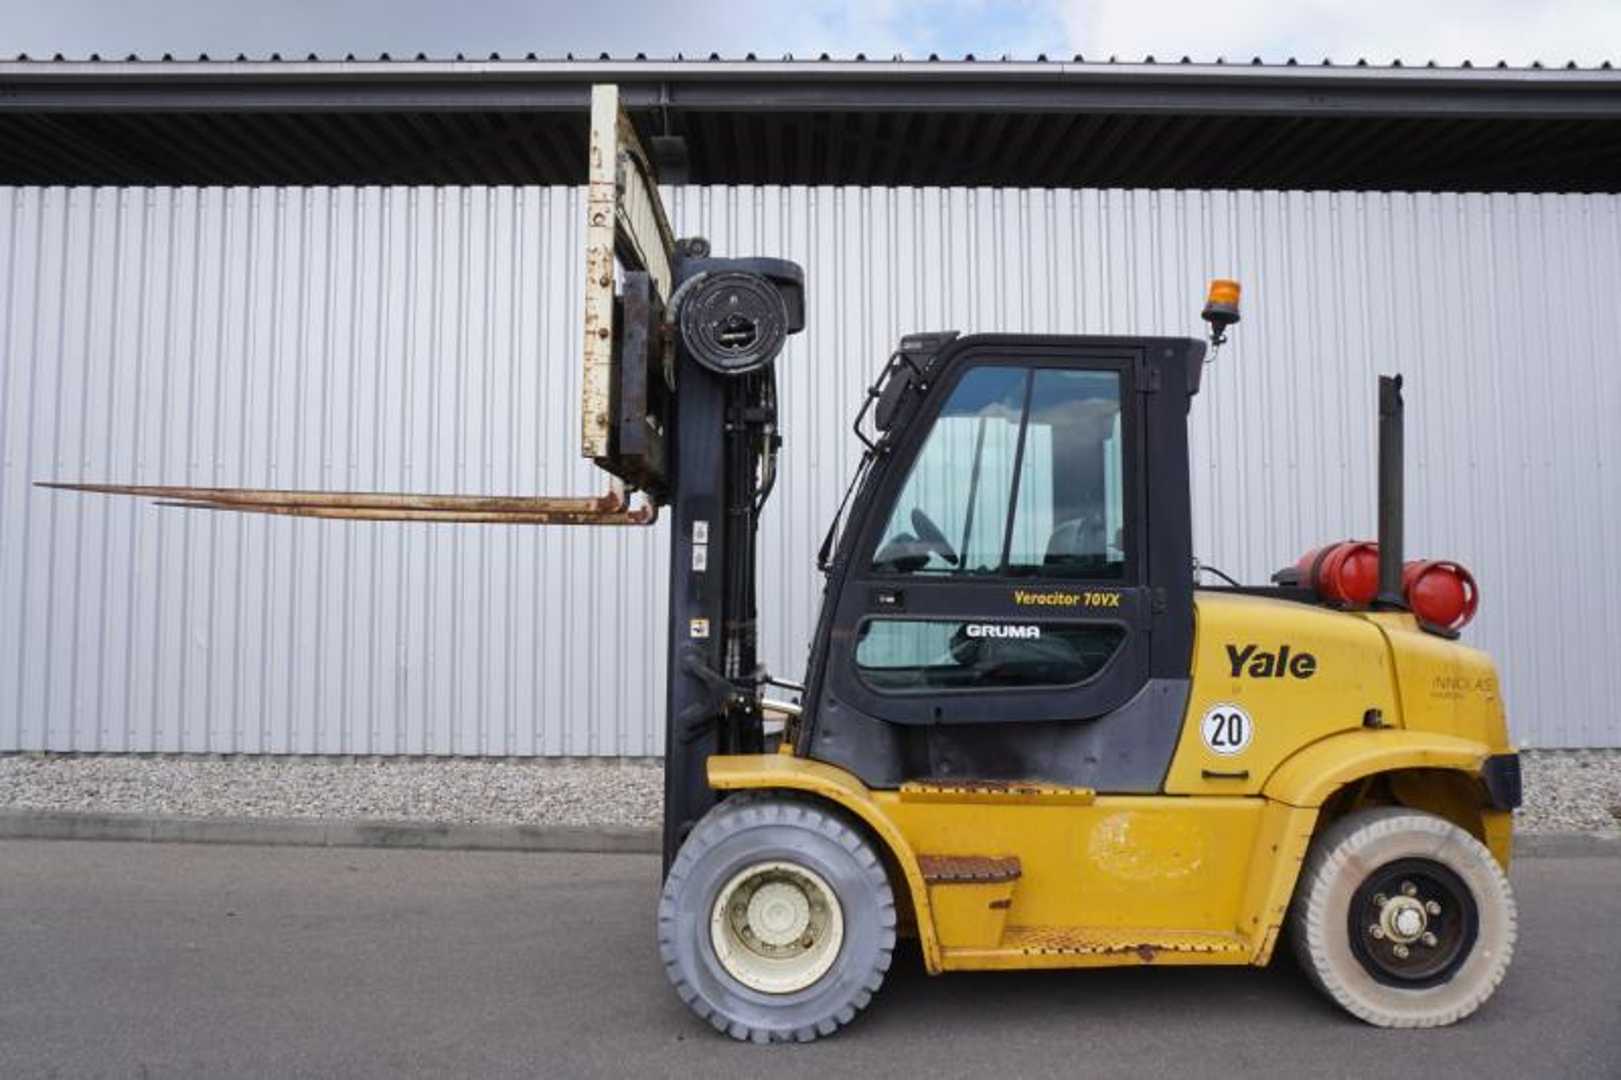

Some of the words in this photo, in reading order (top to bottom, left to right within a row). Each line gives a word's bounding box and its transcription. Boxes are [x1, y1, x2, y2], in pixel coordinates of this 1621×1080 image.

[1084, 592, 1120, 607] 70VX
[966, 624, 1040, 639] GRUMA
[1226, 644, 1316, 679] Yale
[1211, 713, 1242, 746] 20
